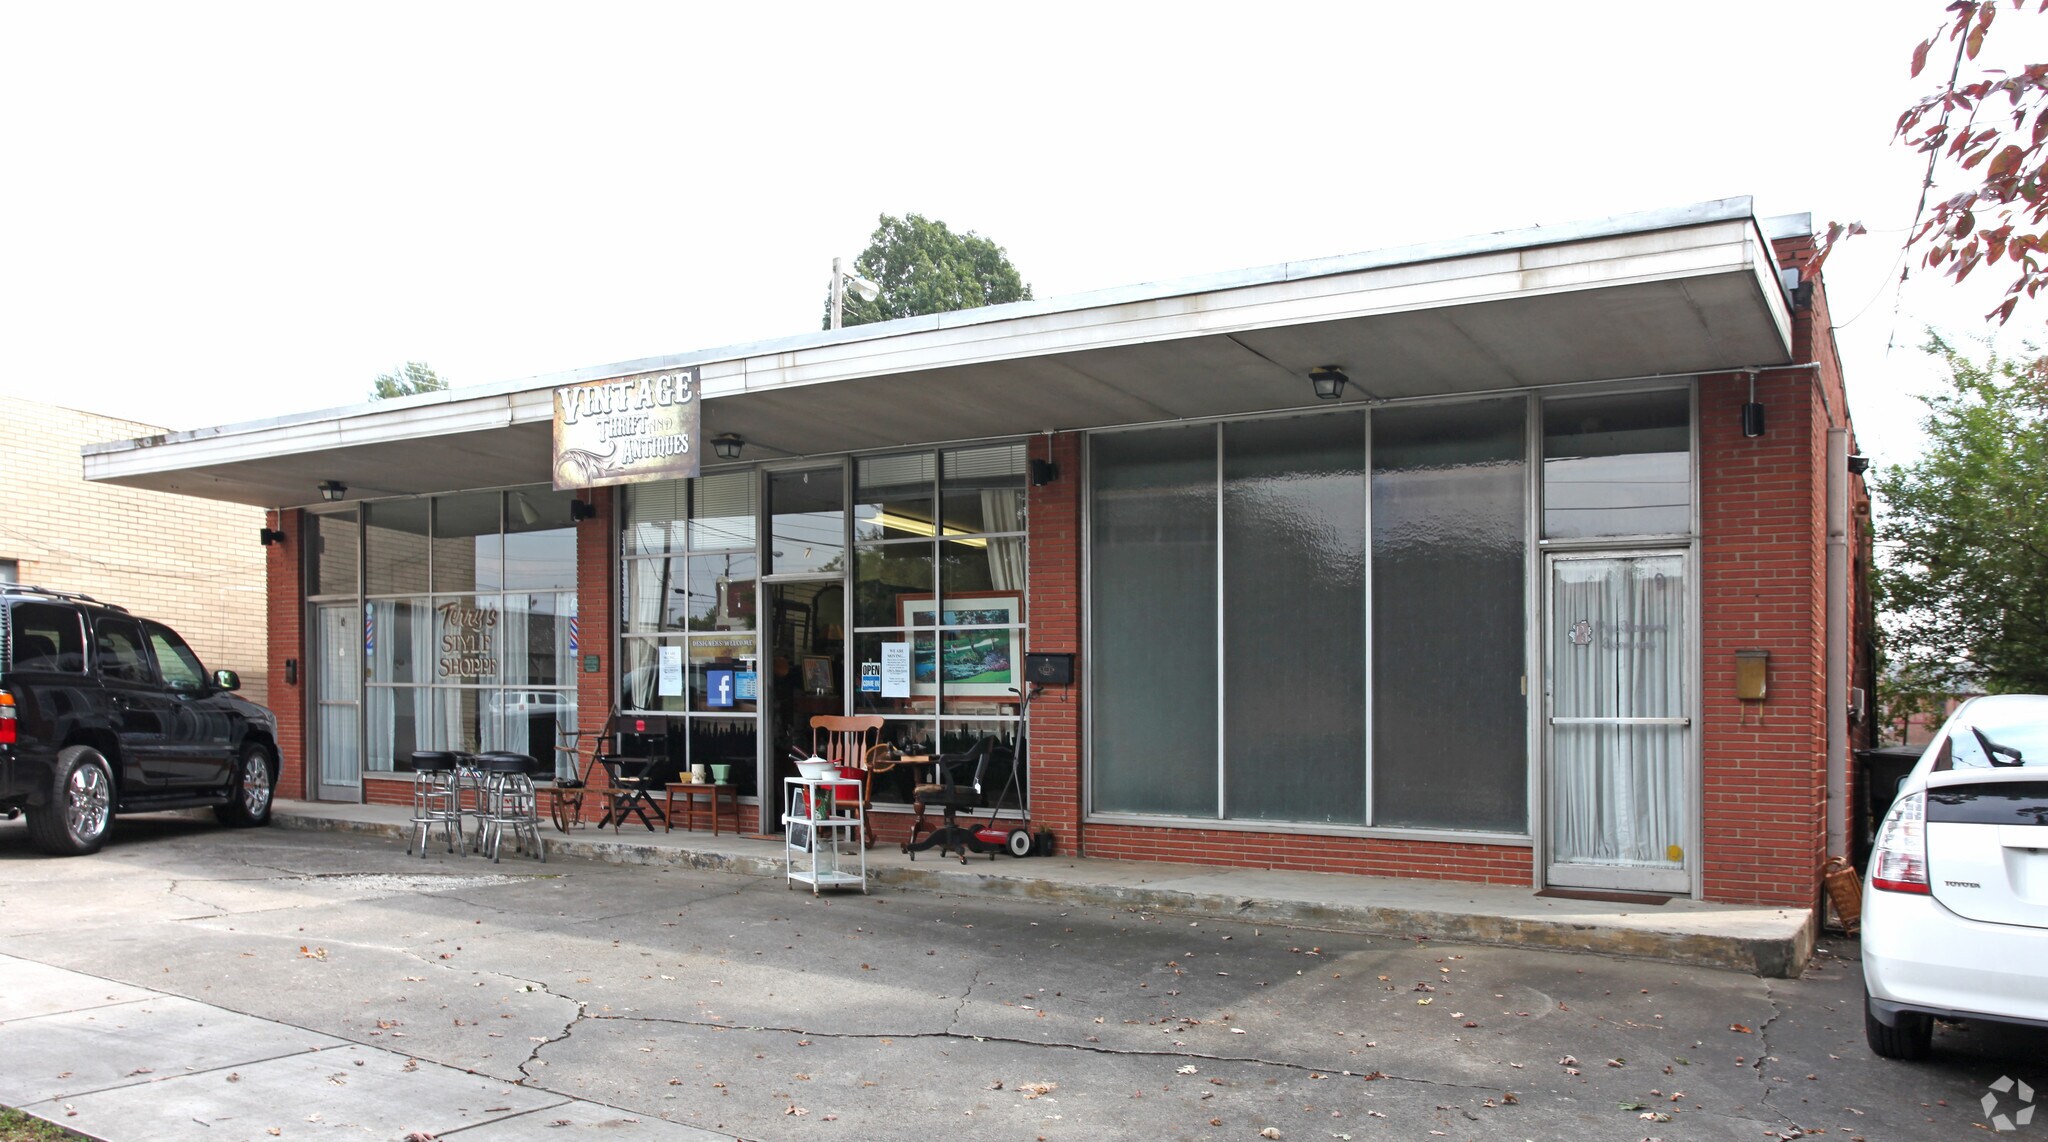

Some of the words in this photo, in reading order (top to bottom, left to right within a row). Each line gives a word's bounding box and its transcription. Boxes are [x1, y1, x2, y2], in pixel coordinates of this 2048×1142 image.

[558, 372, 693, 424] VINTAGE
[597, 413, 649, 442] THRIFT
[622, 433, 689, 464] ANTIQUES
[438, 602, 497, 632] Terry's
[442, 635, 491, 654] STYLE
[438, 658, 498, 679] SHOPPE
[863, 665, 880, 675] OPEN
[719, 675, 729, 704] f
[1944, 880, 1981, 888] TOYOTA
